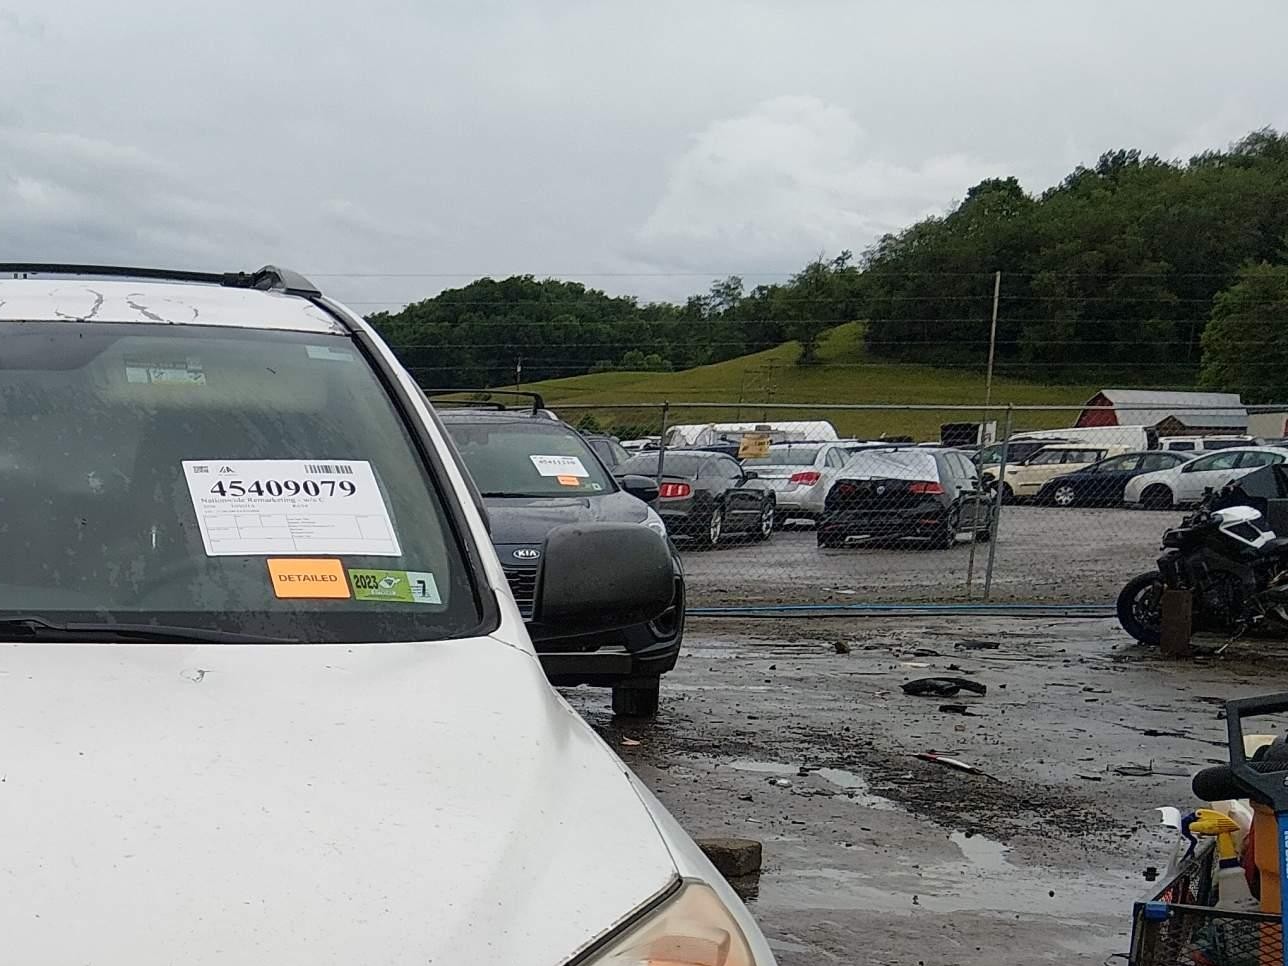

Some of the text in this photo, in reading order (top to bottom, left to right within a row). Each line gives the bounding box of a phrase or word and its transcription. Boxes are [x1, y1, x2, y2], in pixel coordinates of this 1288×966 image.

[210, 480, 356, 497] 45409079
[278, 574, 338, 584] DETAILED
[353, 574, 379, 589] 2023
[417, 580, 426, 597] 7
